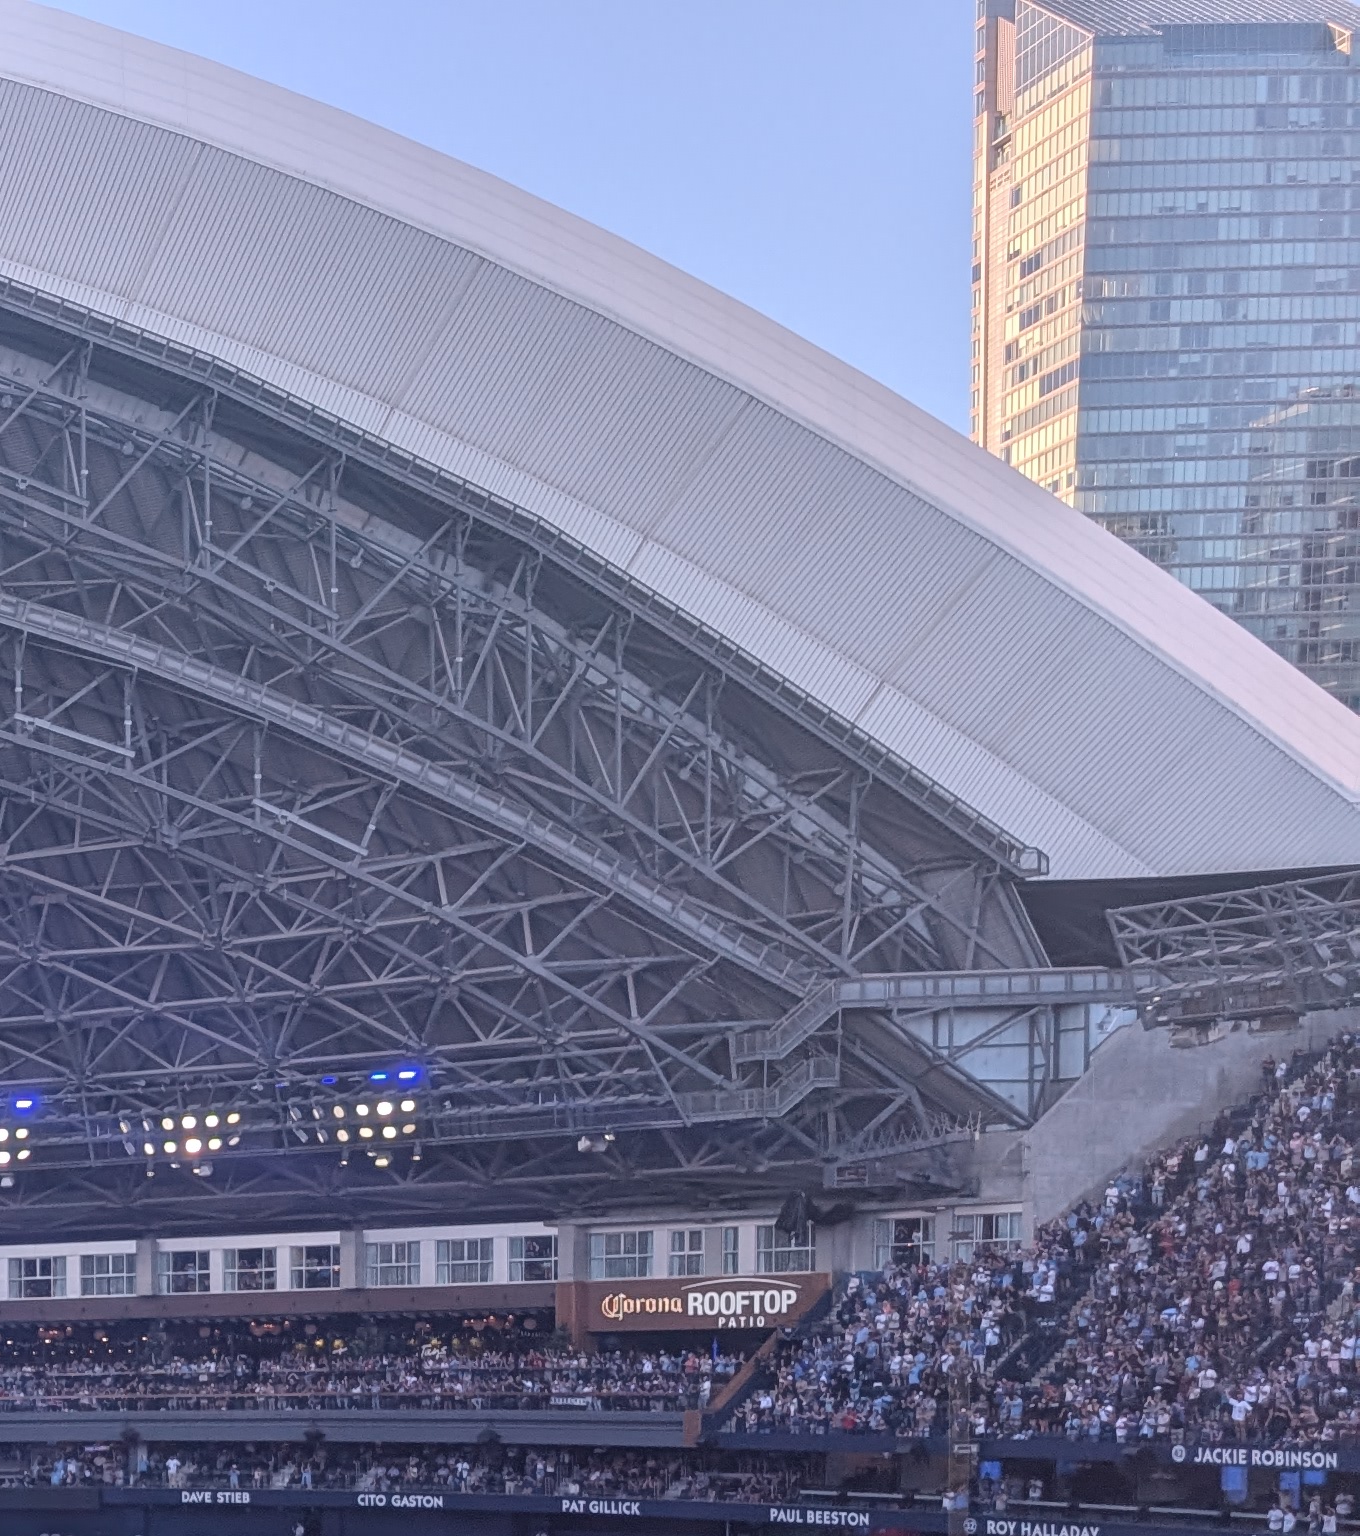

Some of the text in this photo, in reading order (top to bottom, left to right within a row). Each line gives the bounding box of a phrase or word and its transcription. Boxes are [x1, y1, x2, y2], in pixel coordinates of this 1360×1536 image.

[601, 1289, 797, 1321] Corona ROOFTOP
[718, 1315, 765, 1329] PATIO
[1194, 1447, 1247, 1465] JACKIE
[1251, 1449, 1338, 1469] ROBINSON
[181, 1491, 250, 1504] DAVE STIEB
[357, 1494, 444, 1509] CITO GASTON
[562, 1500, 640, 1517] PAT GILLICK
[769, 1508, 869, 1528] PAUL BEESTON
[986, 1520, 1016, 1536] ROY
